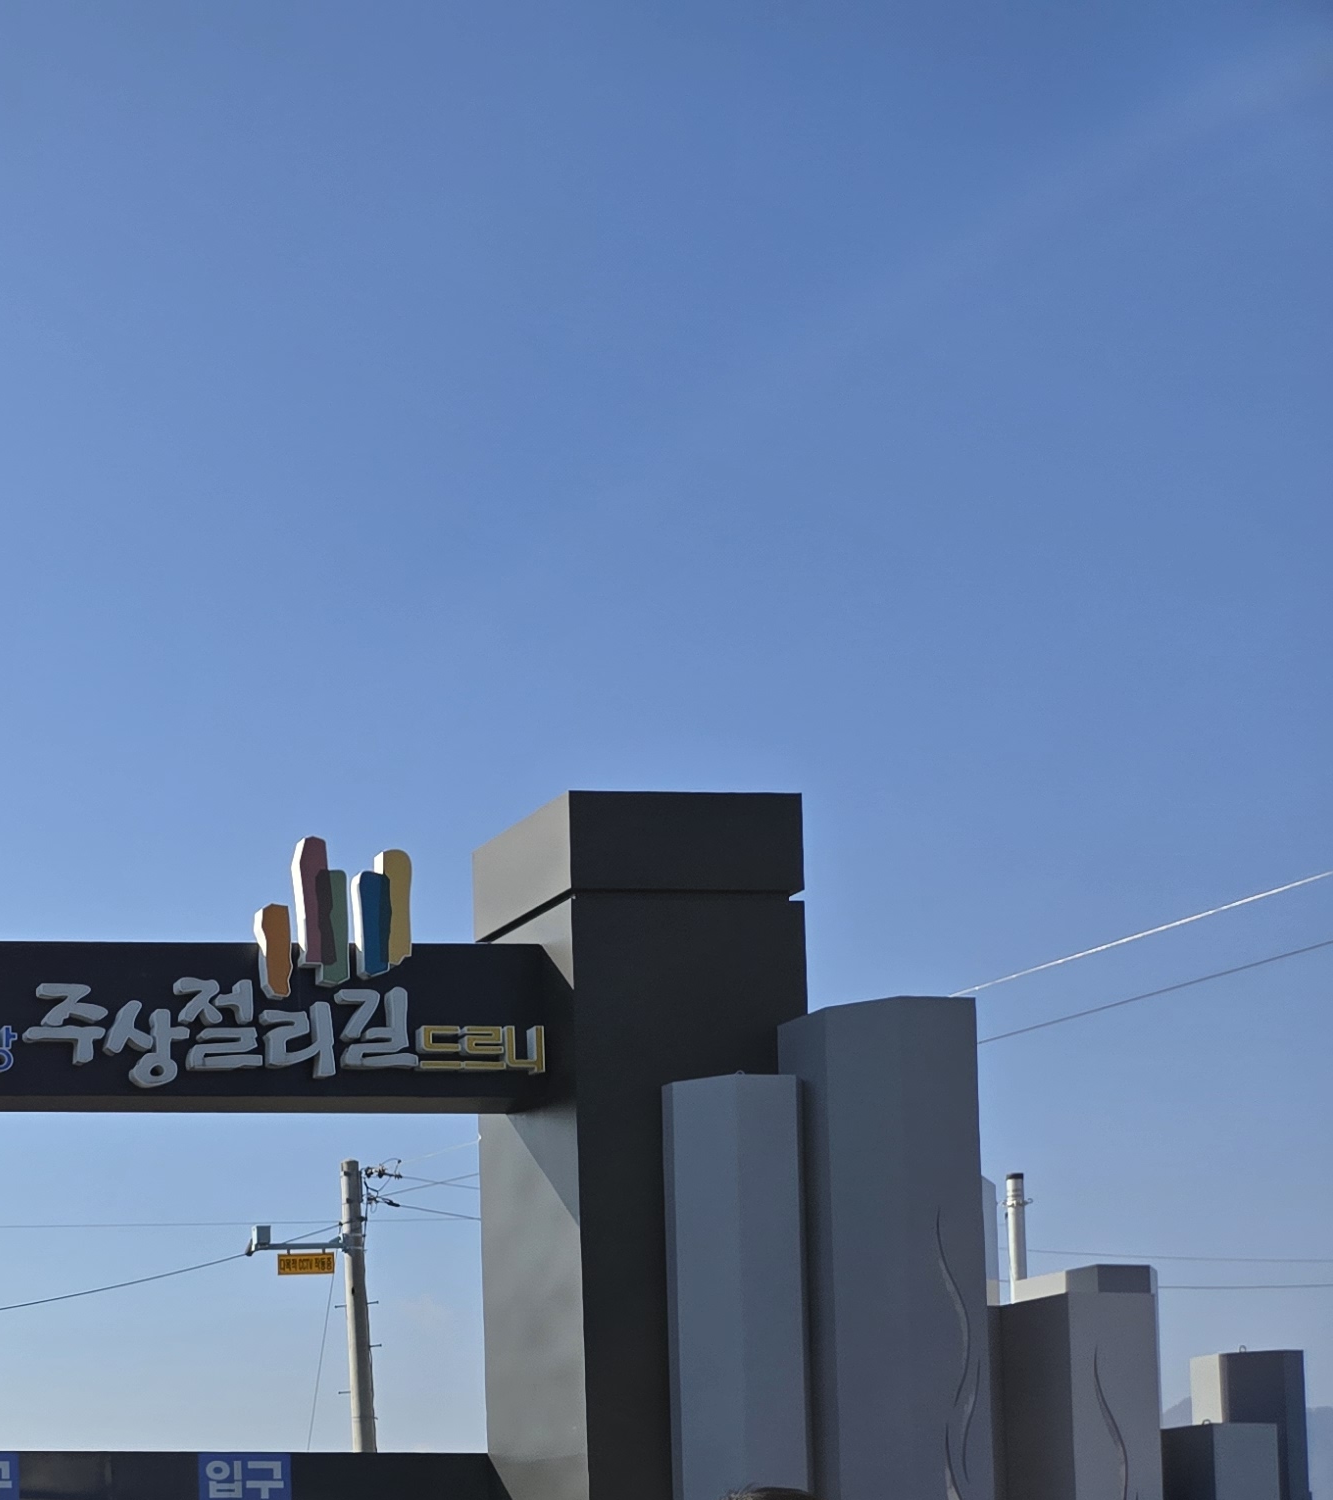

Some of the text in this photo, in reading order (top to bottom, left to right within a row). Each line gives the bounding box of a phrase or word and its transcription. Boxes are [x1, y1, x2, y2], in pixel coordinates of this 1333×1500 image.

[23, 976, 419, 1088] 주상절리길
[416, 1024, 547, 1076] 드르니
[298, 1258, 313, 1271] CCTV
[205, 1460, 285, 1500] 입구
